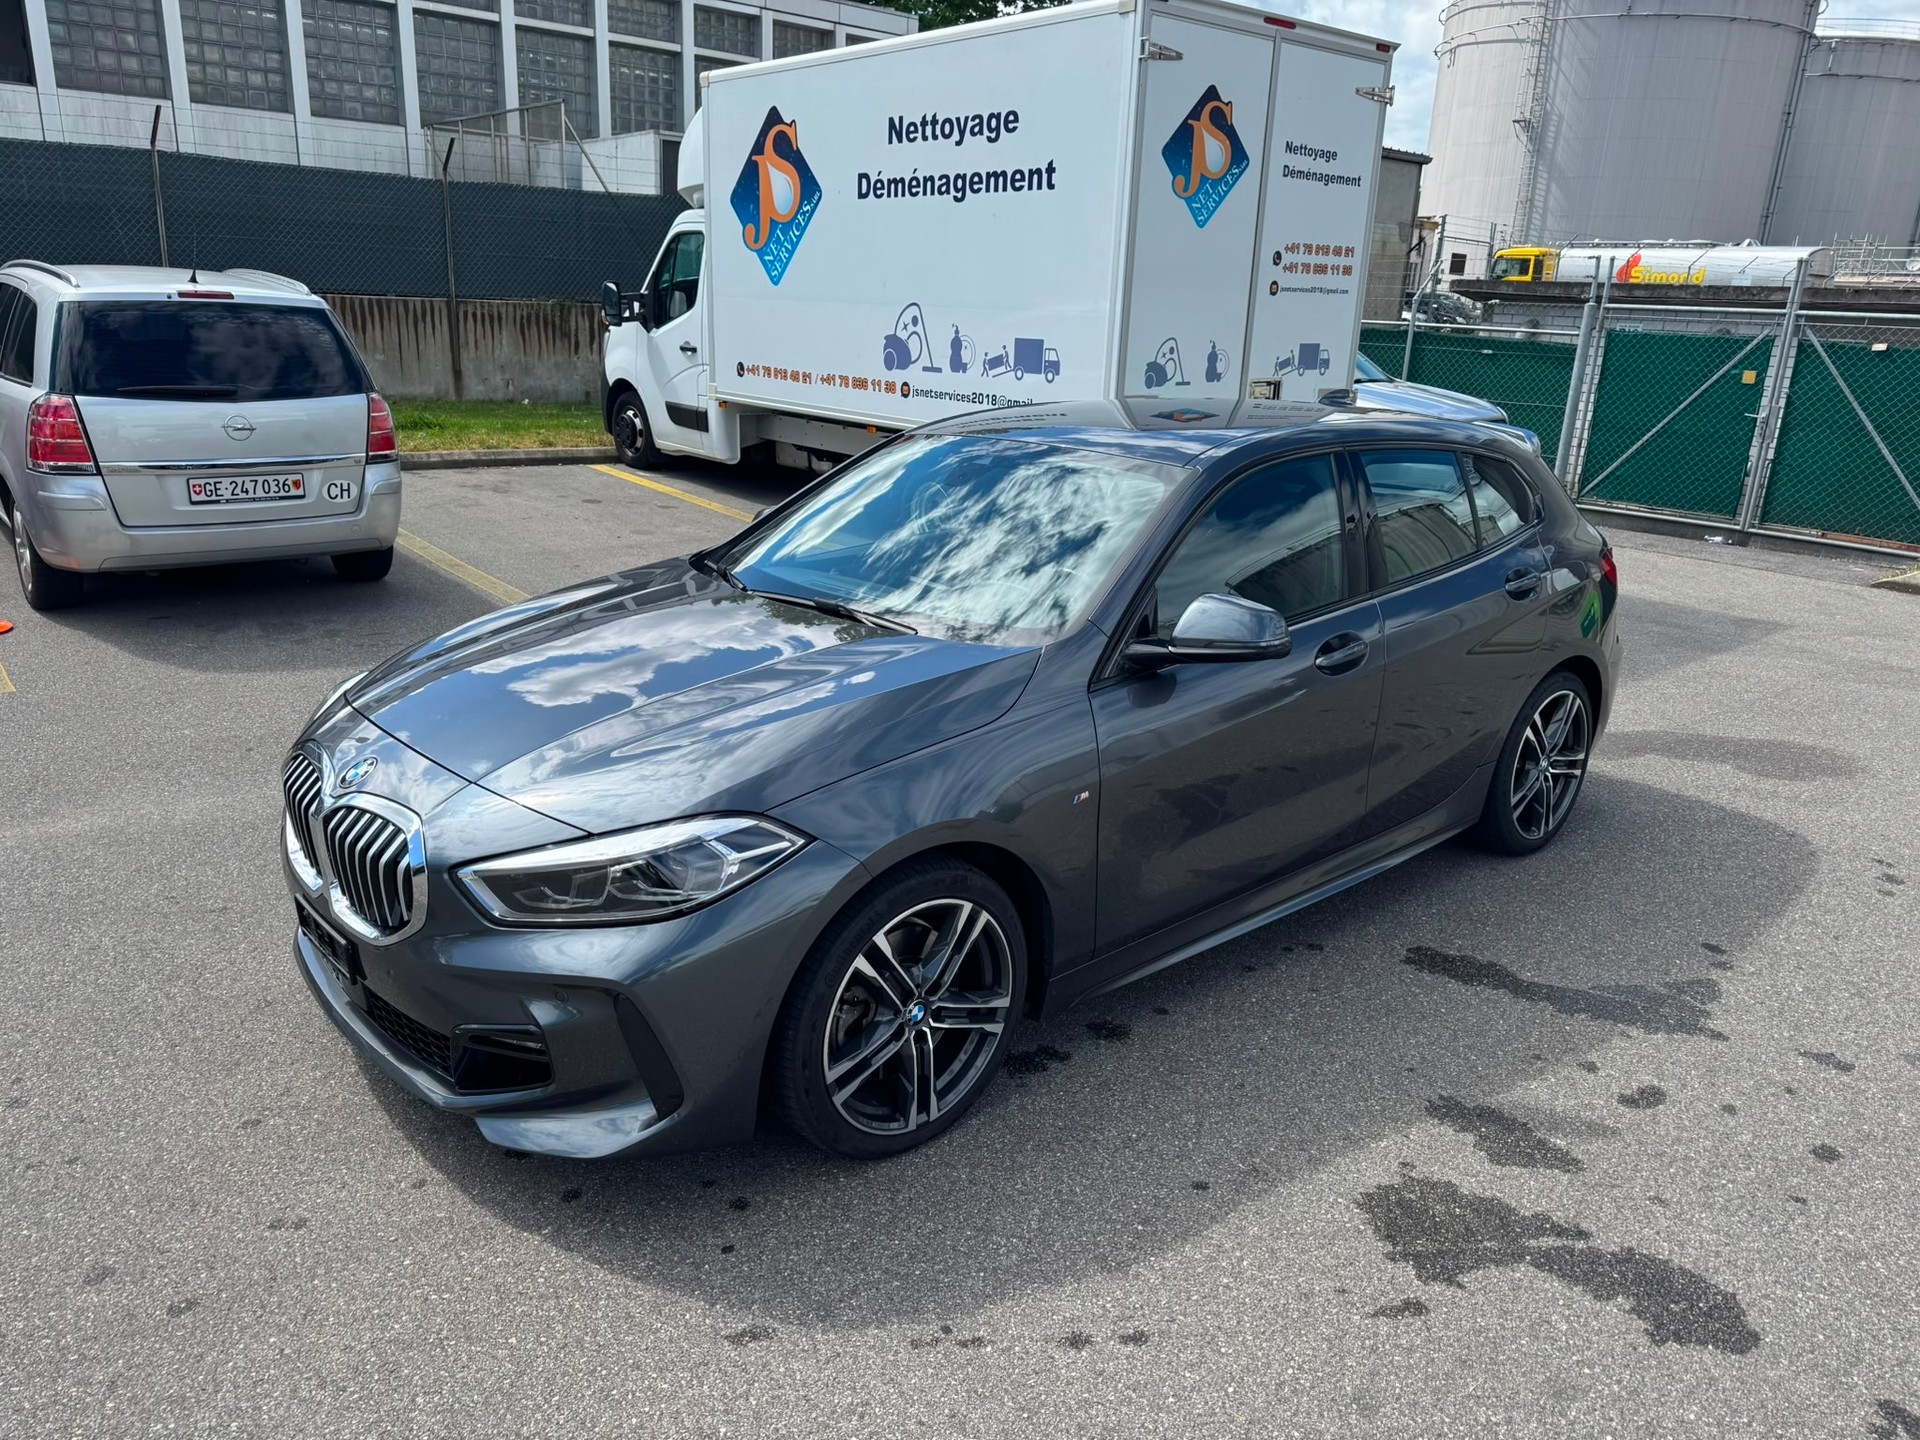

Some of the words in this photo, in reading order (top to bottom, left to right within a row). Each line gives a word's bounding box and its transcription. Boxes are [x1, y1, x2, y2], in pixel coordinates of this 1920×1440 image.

[888, 109, 1020, 147] Nettoyage
[1285, 140, 1338, 163] Nettoyage
[857, 159, 1057, 203] Déménagement
[1282, 164, 1362, 187] Déménagement
[1191, 179, 1213, 213] NET
[1197, 164, 1239, 225] SERVICES
[763, 224, 785, 267] NET
[770, 200, 812, 281] SERVICES
[1284, 242, 1300, 255] +41
[1282, 261, 1298, 274] +41
[1330, 263, 1340, 275] 11
[1630, 265, 1706, 285] Simond
[746, 364, 760, 376] +41
[820, 373, 836, 386] +41
[870, 378, 881, 392] 11
[884, 380, 897, 394] 38
[327, 482, 351, 500] CH
